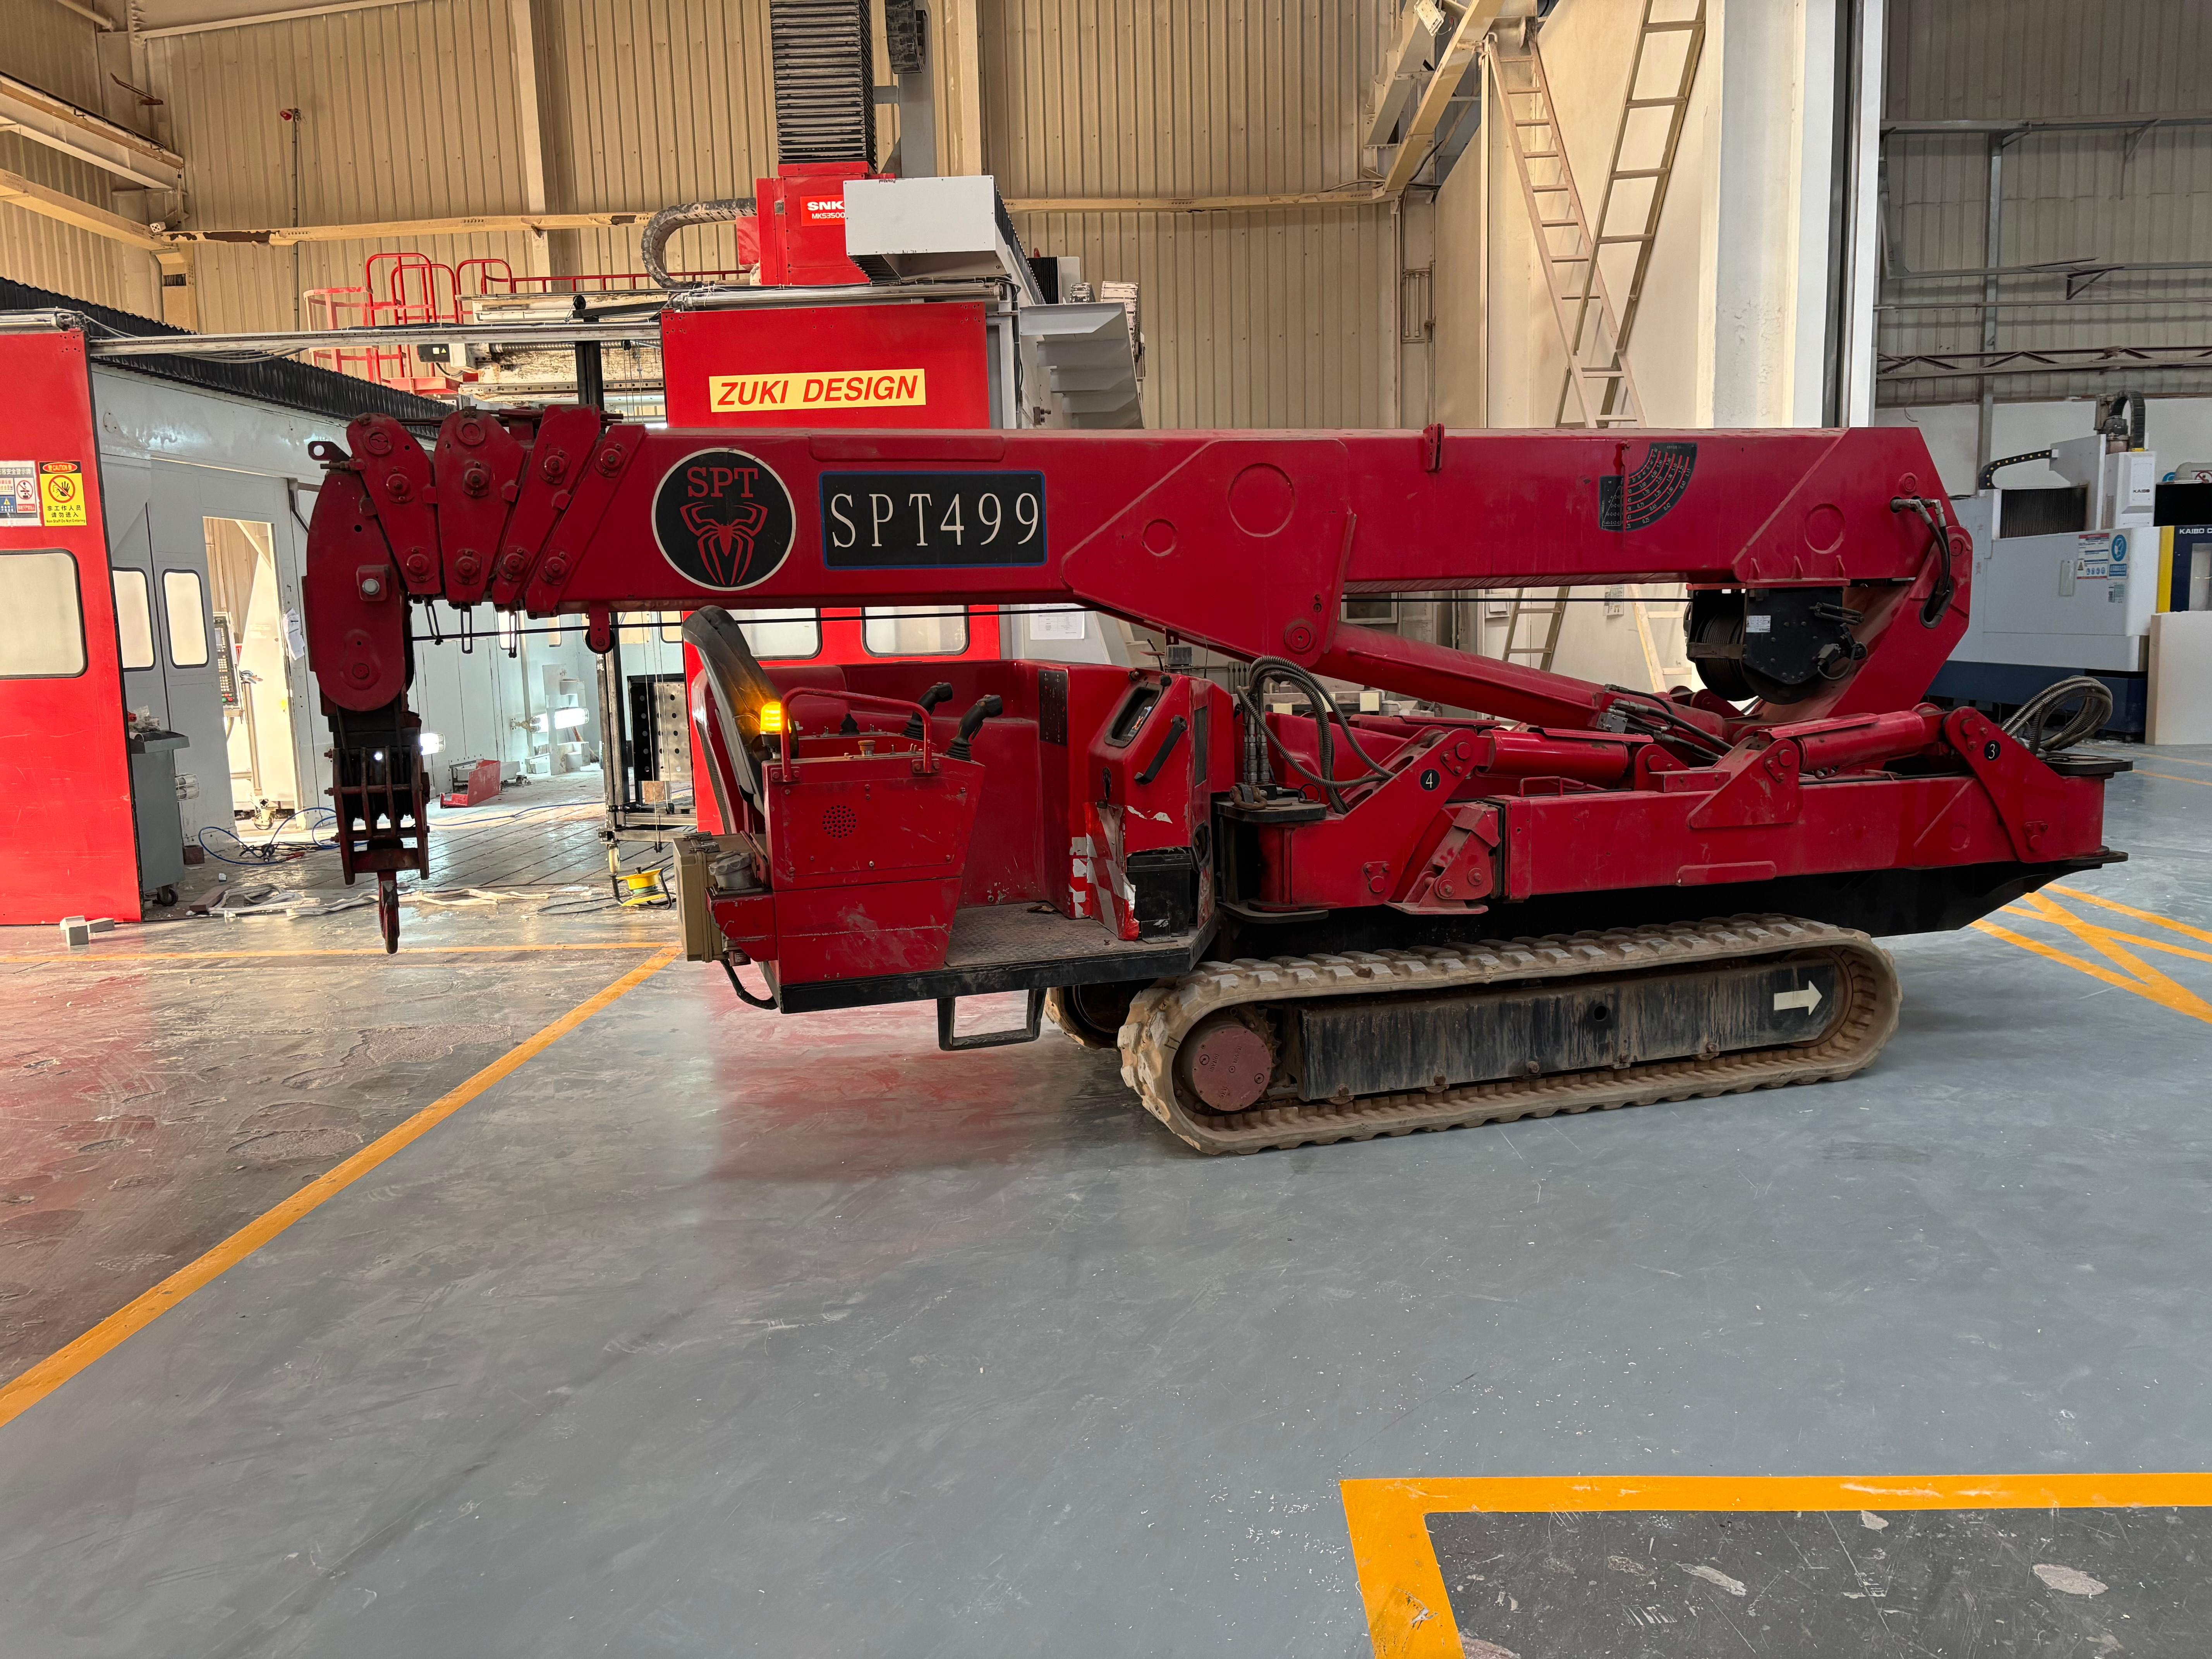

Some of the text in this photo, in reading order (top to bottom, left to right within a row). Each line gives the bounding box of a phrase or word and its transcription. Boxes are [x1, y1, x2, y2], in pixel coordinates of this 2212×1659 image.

[807, 201, 844, 211] SNK
[717, 375, 918, 405] ZUKI DESIGN
[687, 467, 758, 498] SPT
[831, 492, 1039, 548] SPT499
[1989, 744, 1995, 759] 3
[1425, 772, 1433, 788] 4
